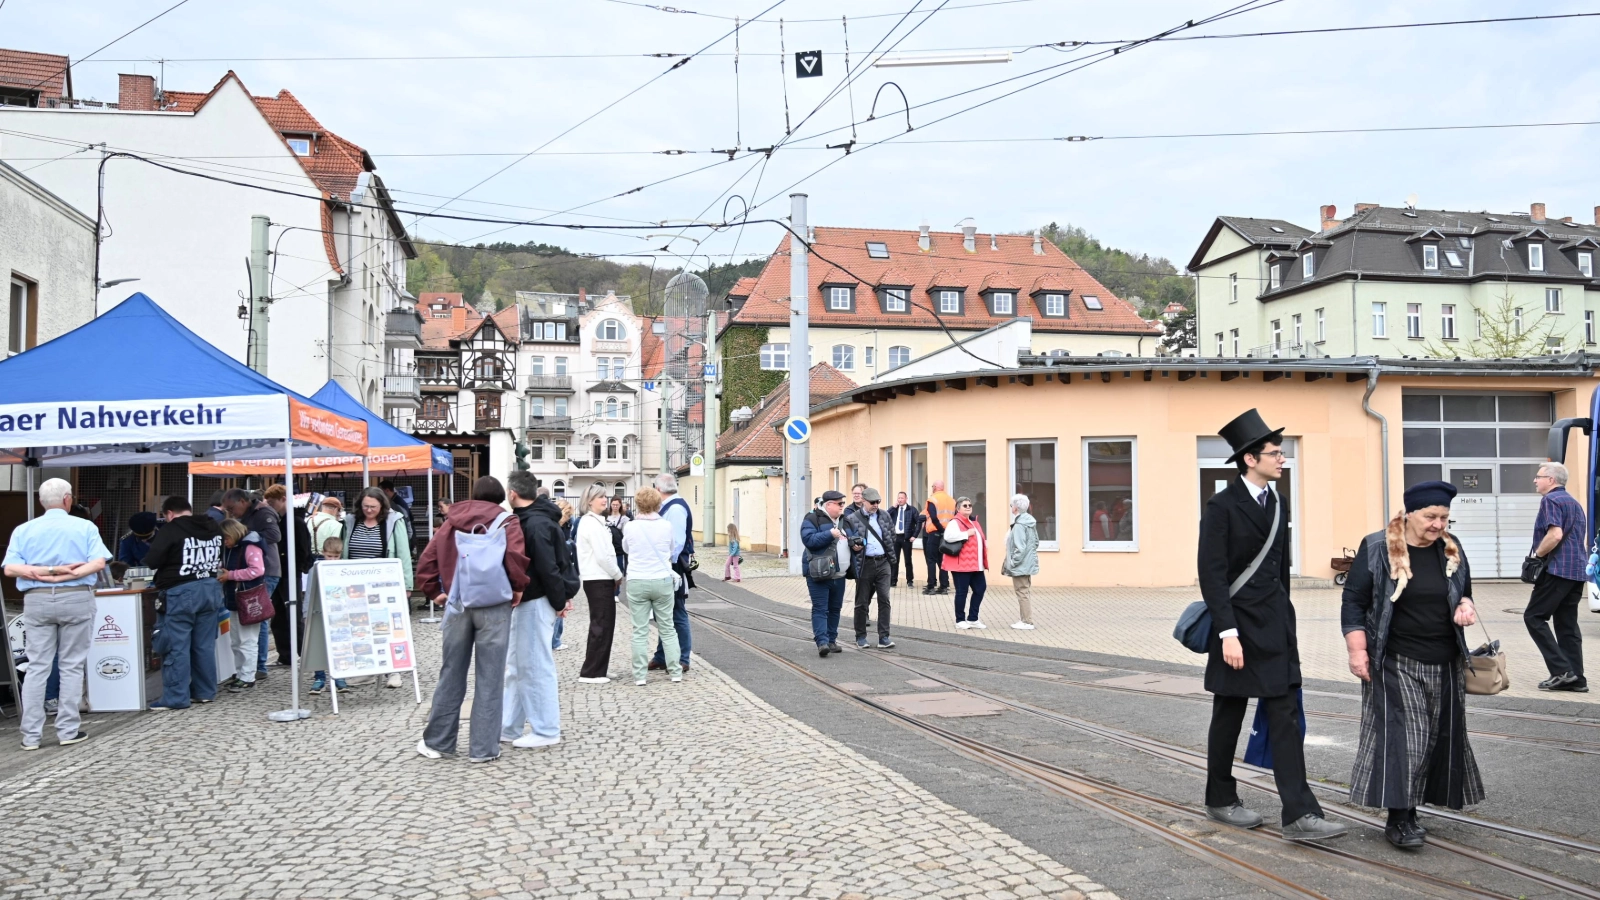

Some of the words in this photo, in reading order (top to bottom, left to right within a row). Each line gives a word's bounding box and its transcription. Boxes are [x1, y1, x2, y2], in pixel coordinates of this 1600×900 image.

[706, 366, 714, 374] W
[0, 412, 46, 432] aer
[58, 404, 226, 429] Nahverkehr
[241, 458, 310, 467] verbinen
[314, 453, 410, 466] Generaionen.
[340, 566, 382, 576] Souvenirs
